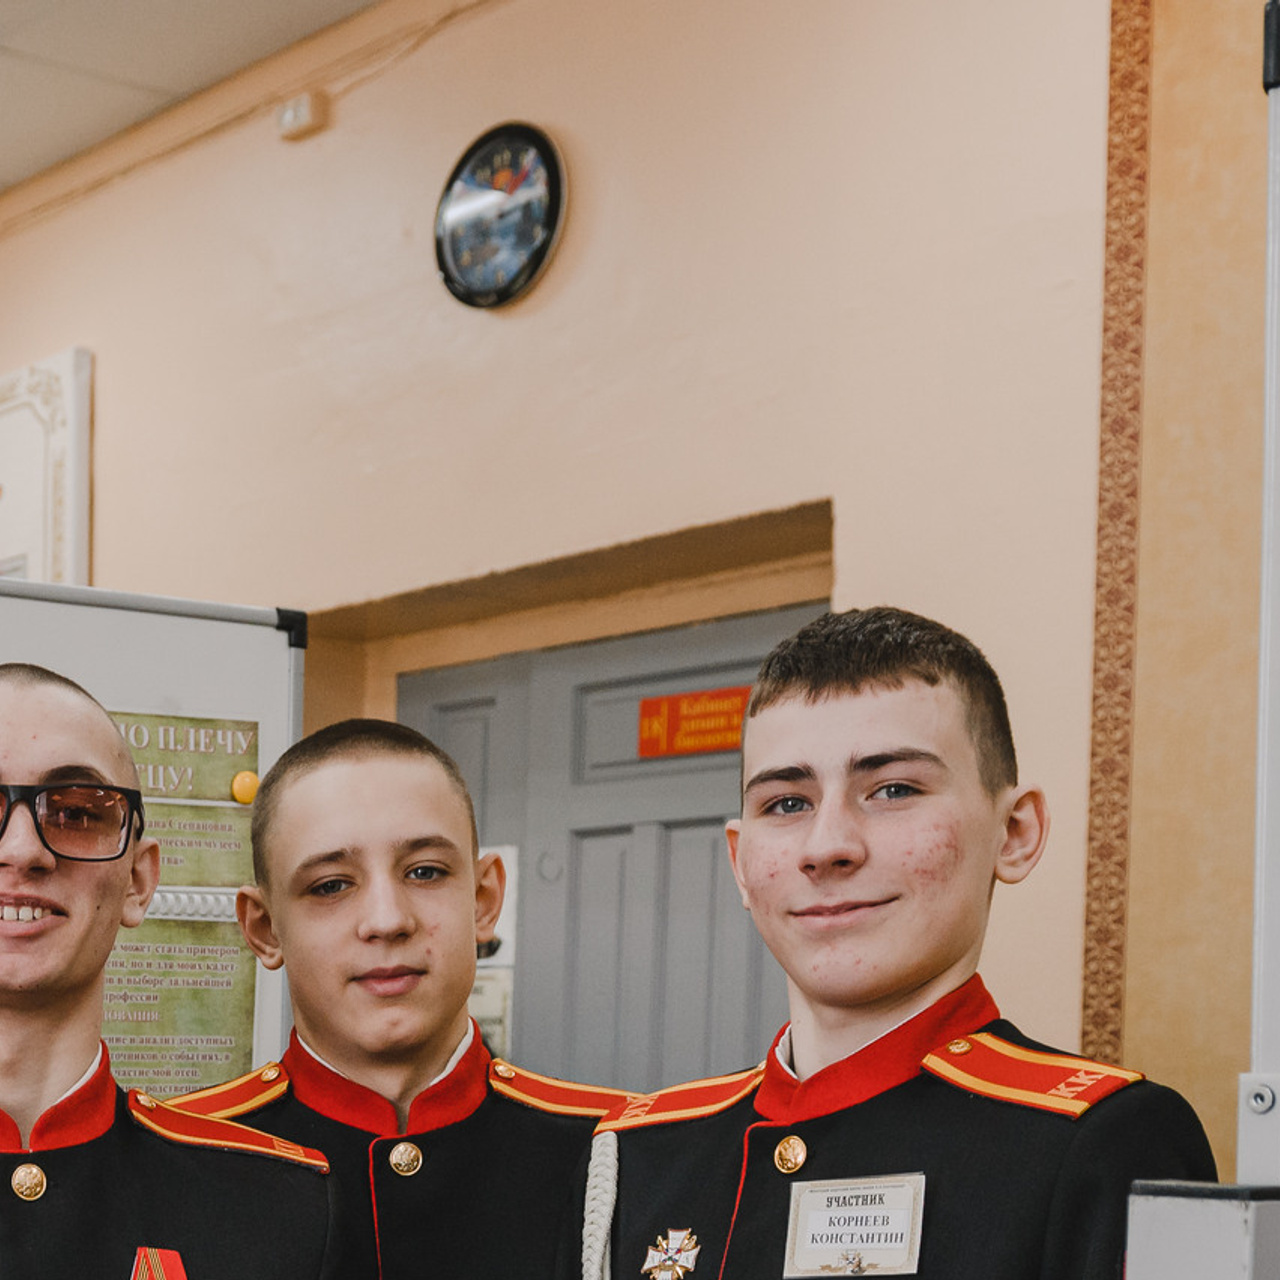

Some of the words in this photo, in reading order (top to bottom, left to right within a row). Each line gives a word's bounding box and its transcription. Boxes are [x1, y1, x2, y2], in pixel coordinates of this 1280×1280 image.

[121, 722, 150, 749] О
[158, 725, 254, 755] ПЛЕЧУ
[136, 764, 194, 792] ЦУ!
[186, 946, 239, 957] примером
[126, 974, 164, 988] выборе
[106, 1037, 126, 1045] ние
[110, 1052, 159, 1062] точников
[115, 1068, 152, 1078] частие
[826, 1193, 885, 1208] УЧАСТНИК
[828, 1215, 890, 1228] КОРНЕЕВ
[811, 1231, 905, 1245] КОНСТАНТИН
